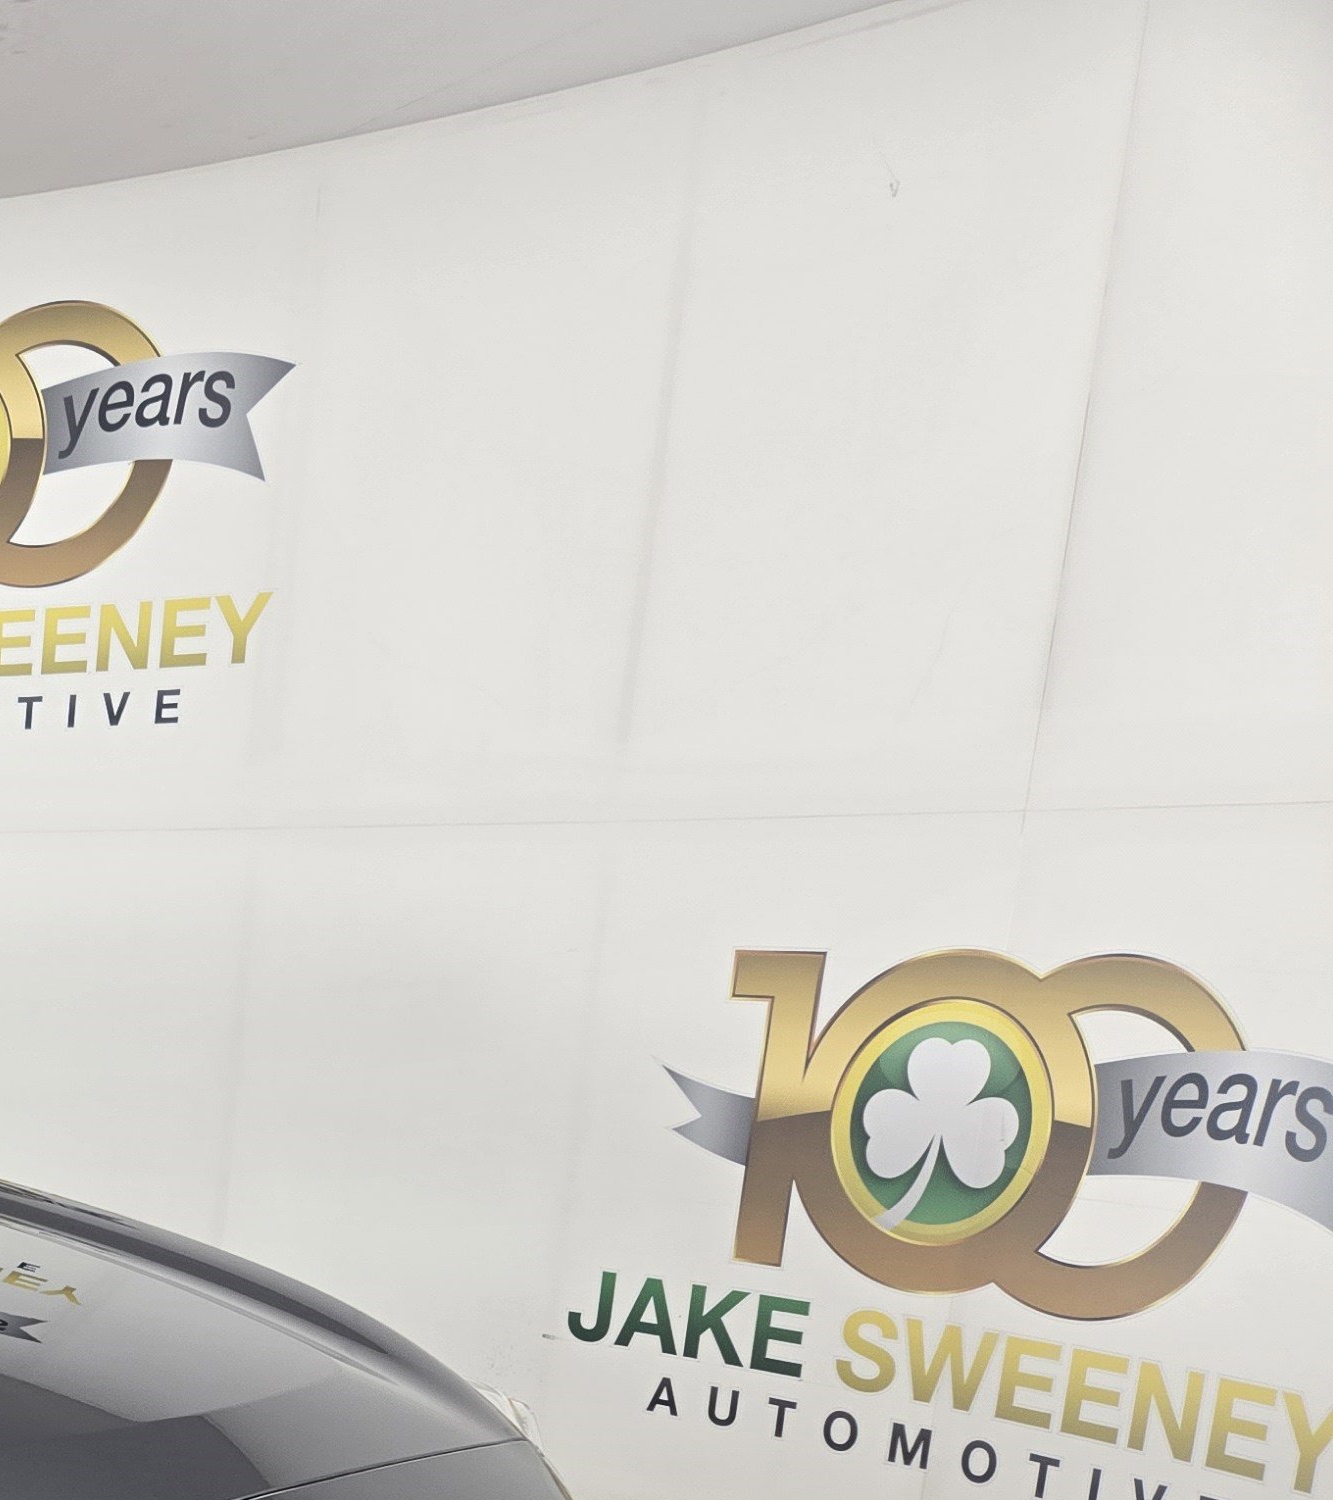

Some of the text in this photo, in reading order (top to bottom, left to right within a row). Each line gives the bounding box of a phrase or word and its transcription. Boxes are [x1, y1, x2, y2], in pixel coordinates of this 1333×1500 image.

[56, 368, 234, 459] years
[732, 948, 1332, 1321] 100 years
[567, 1270, 1333, 1495] JAKE SWEENEY
